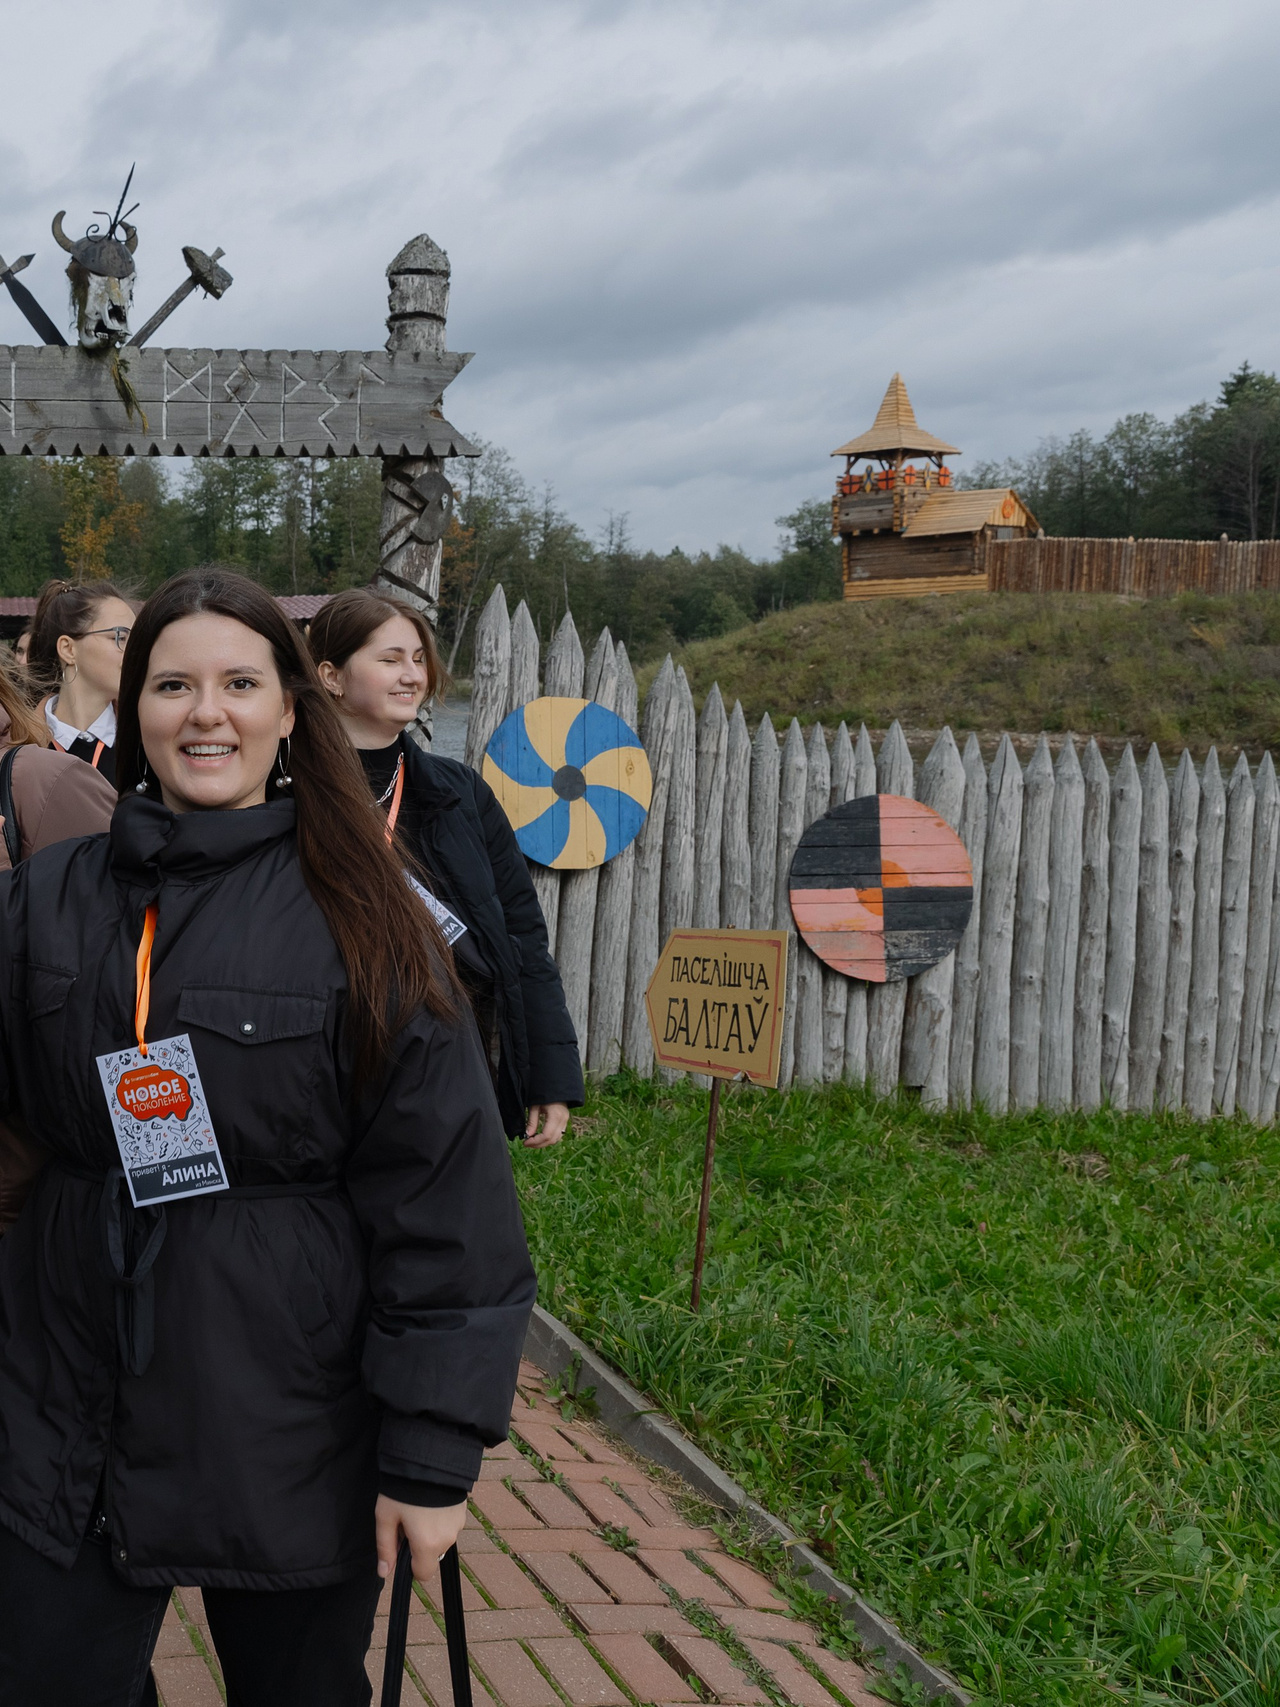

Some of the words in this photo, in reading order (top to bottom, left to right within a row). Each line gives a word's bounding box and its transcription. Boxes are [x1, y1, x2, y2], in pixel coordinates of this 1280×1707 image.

[670, 952, 770, 990] ПАСЕЛІШЧА
[663, 995, 770, 1054] БАЛТАЎ
[123, 1078, 182, 1106] НОВОЕ
[132, 1093, 187, 1113] ПОКОЛЕНИЕ
[131, 1164, 160, 1179] привет!
[162, 1161, 219, 1187] АЛИНА
